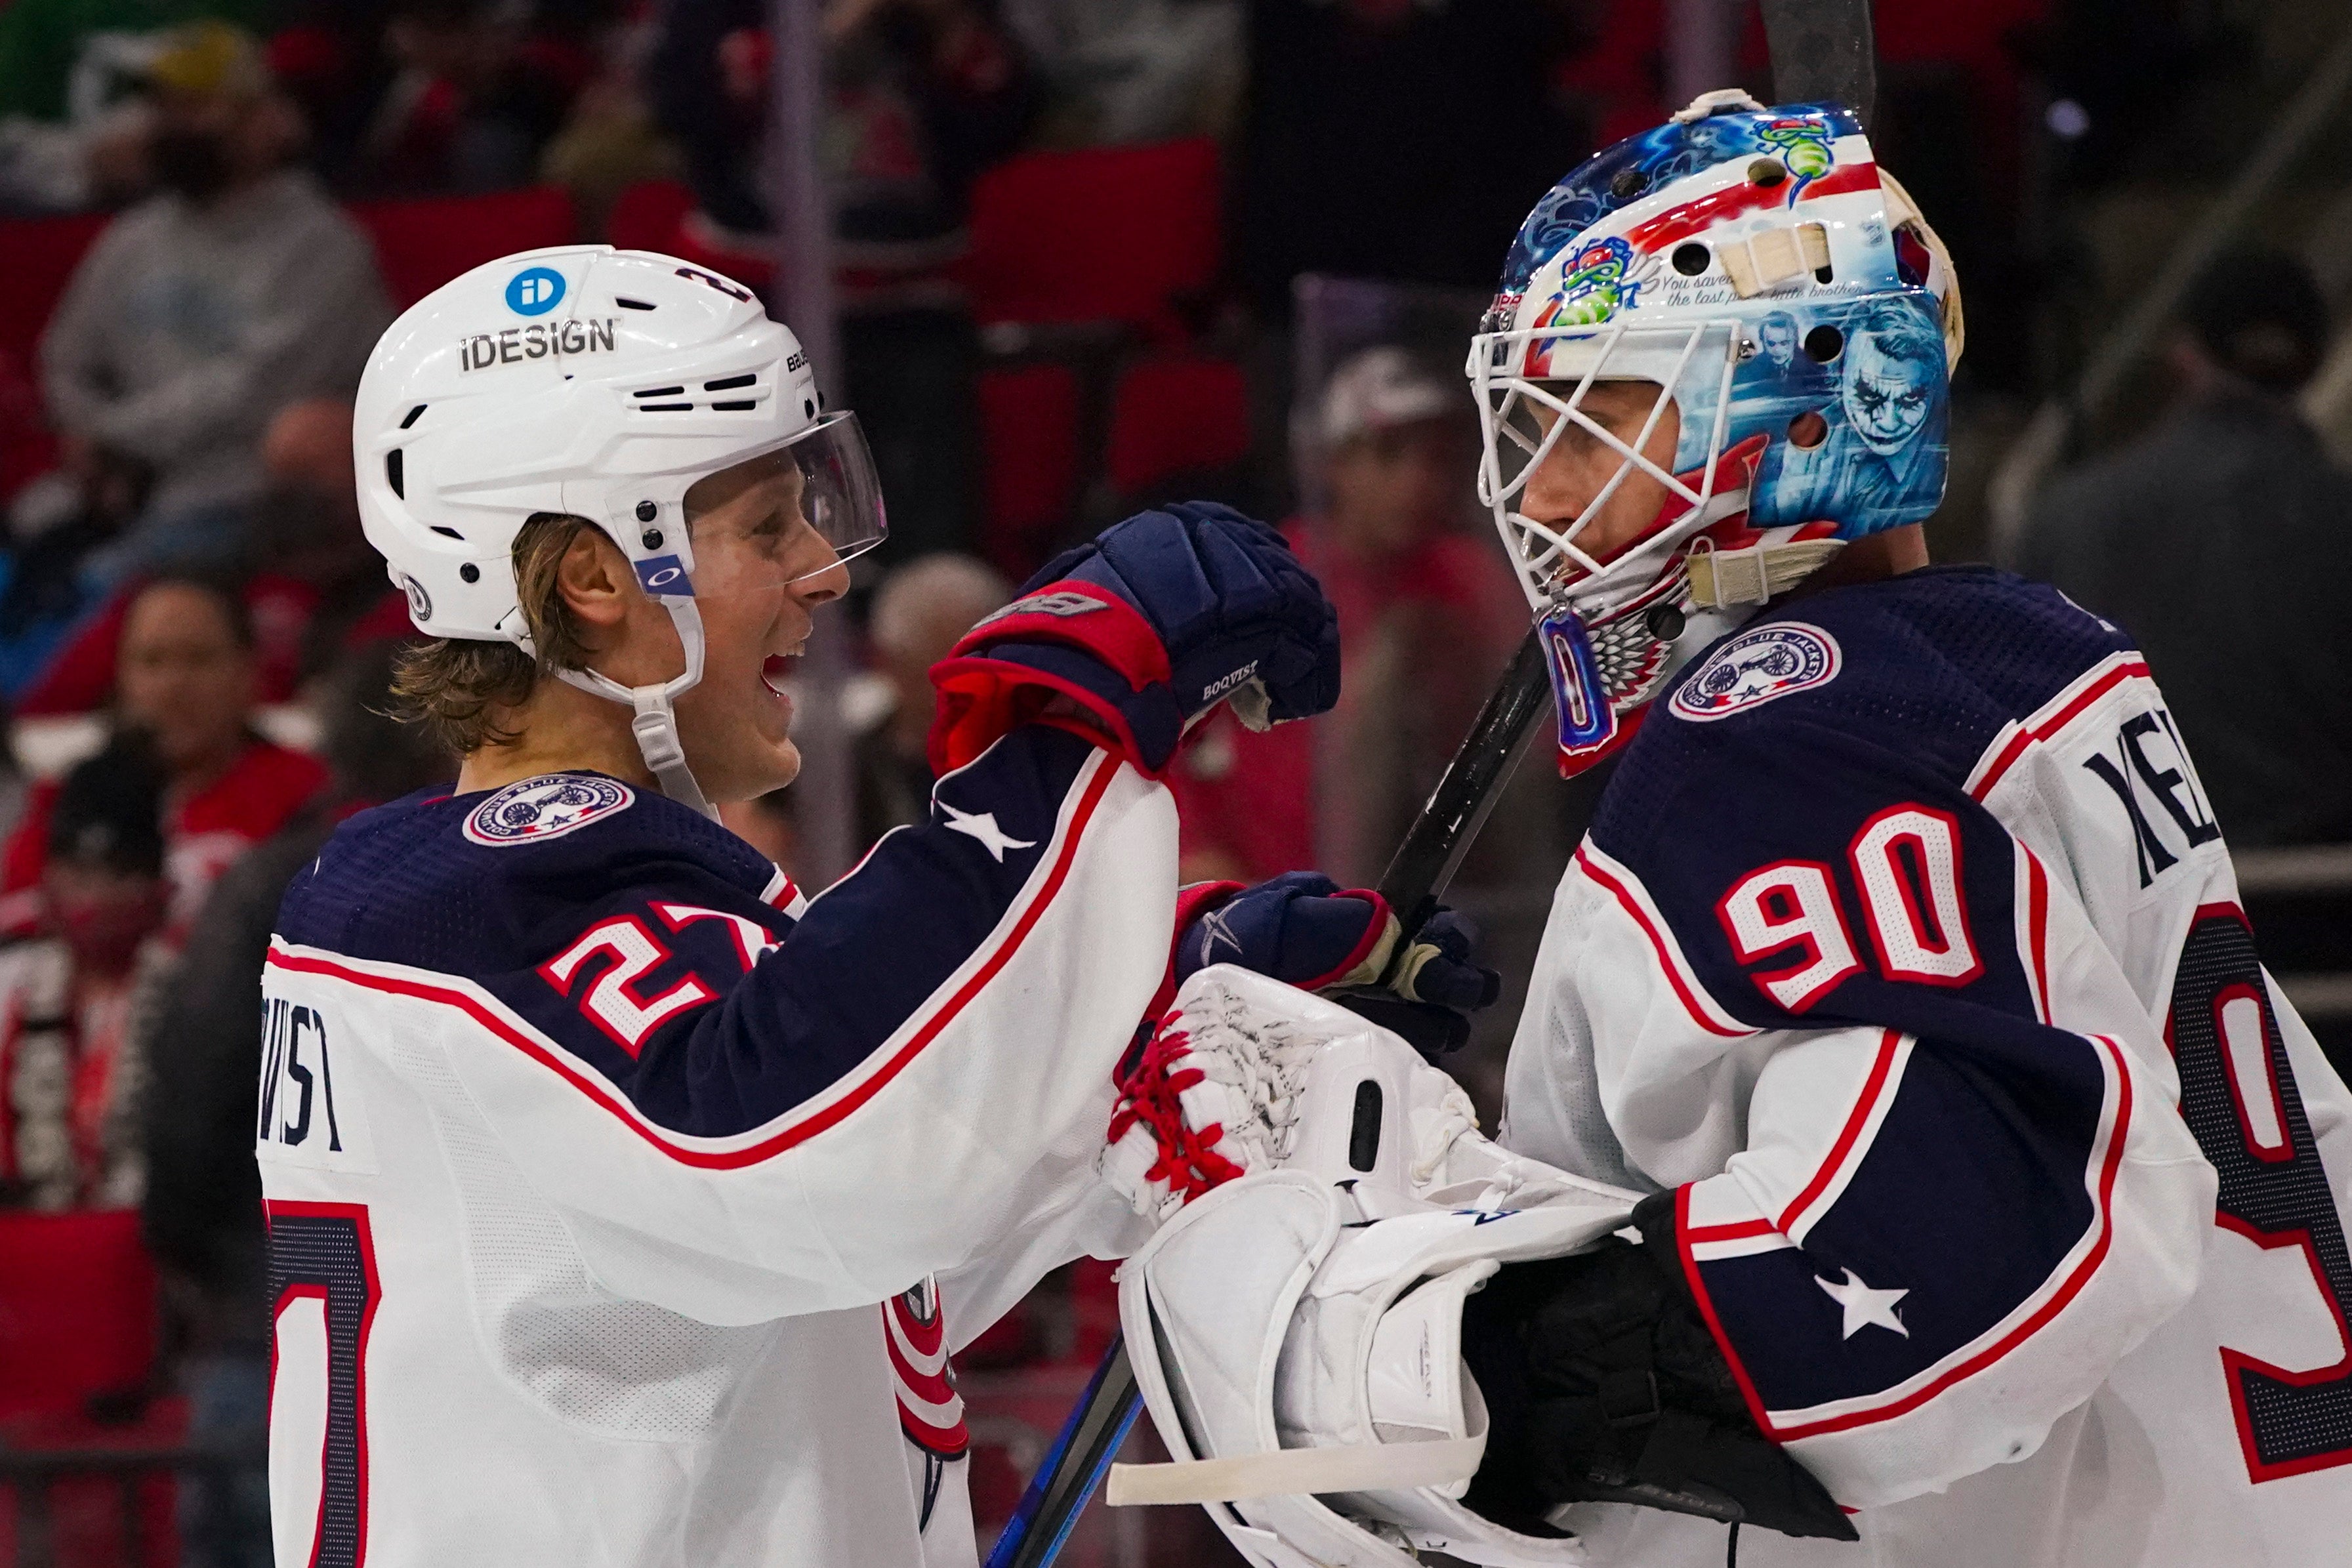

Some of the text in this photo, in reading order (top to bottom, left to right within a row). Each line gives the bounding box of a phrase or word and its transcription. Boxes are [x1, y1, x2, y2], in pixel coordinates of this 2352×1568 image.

[1662, 275, 1690, 291] You
[1667, 291, 1691, 306] the
[1695, 290, 1725, 305] last
[1203, 659, 1258, 701] BOQVIST
[1715, 801, 1985, 1015] 90
